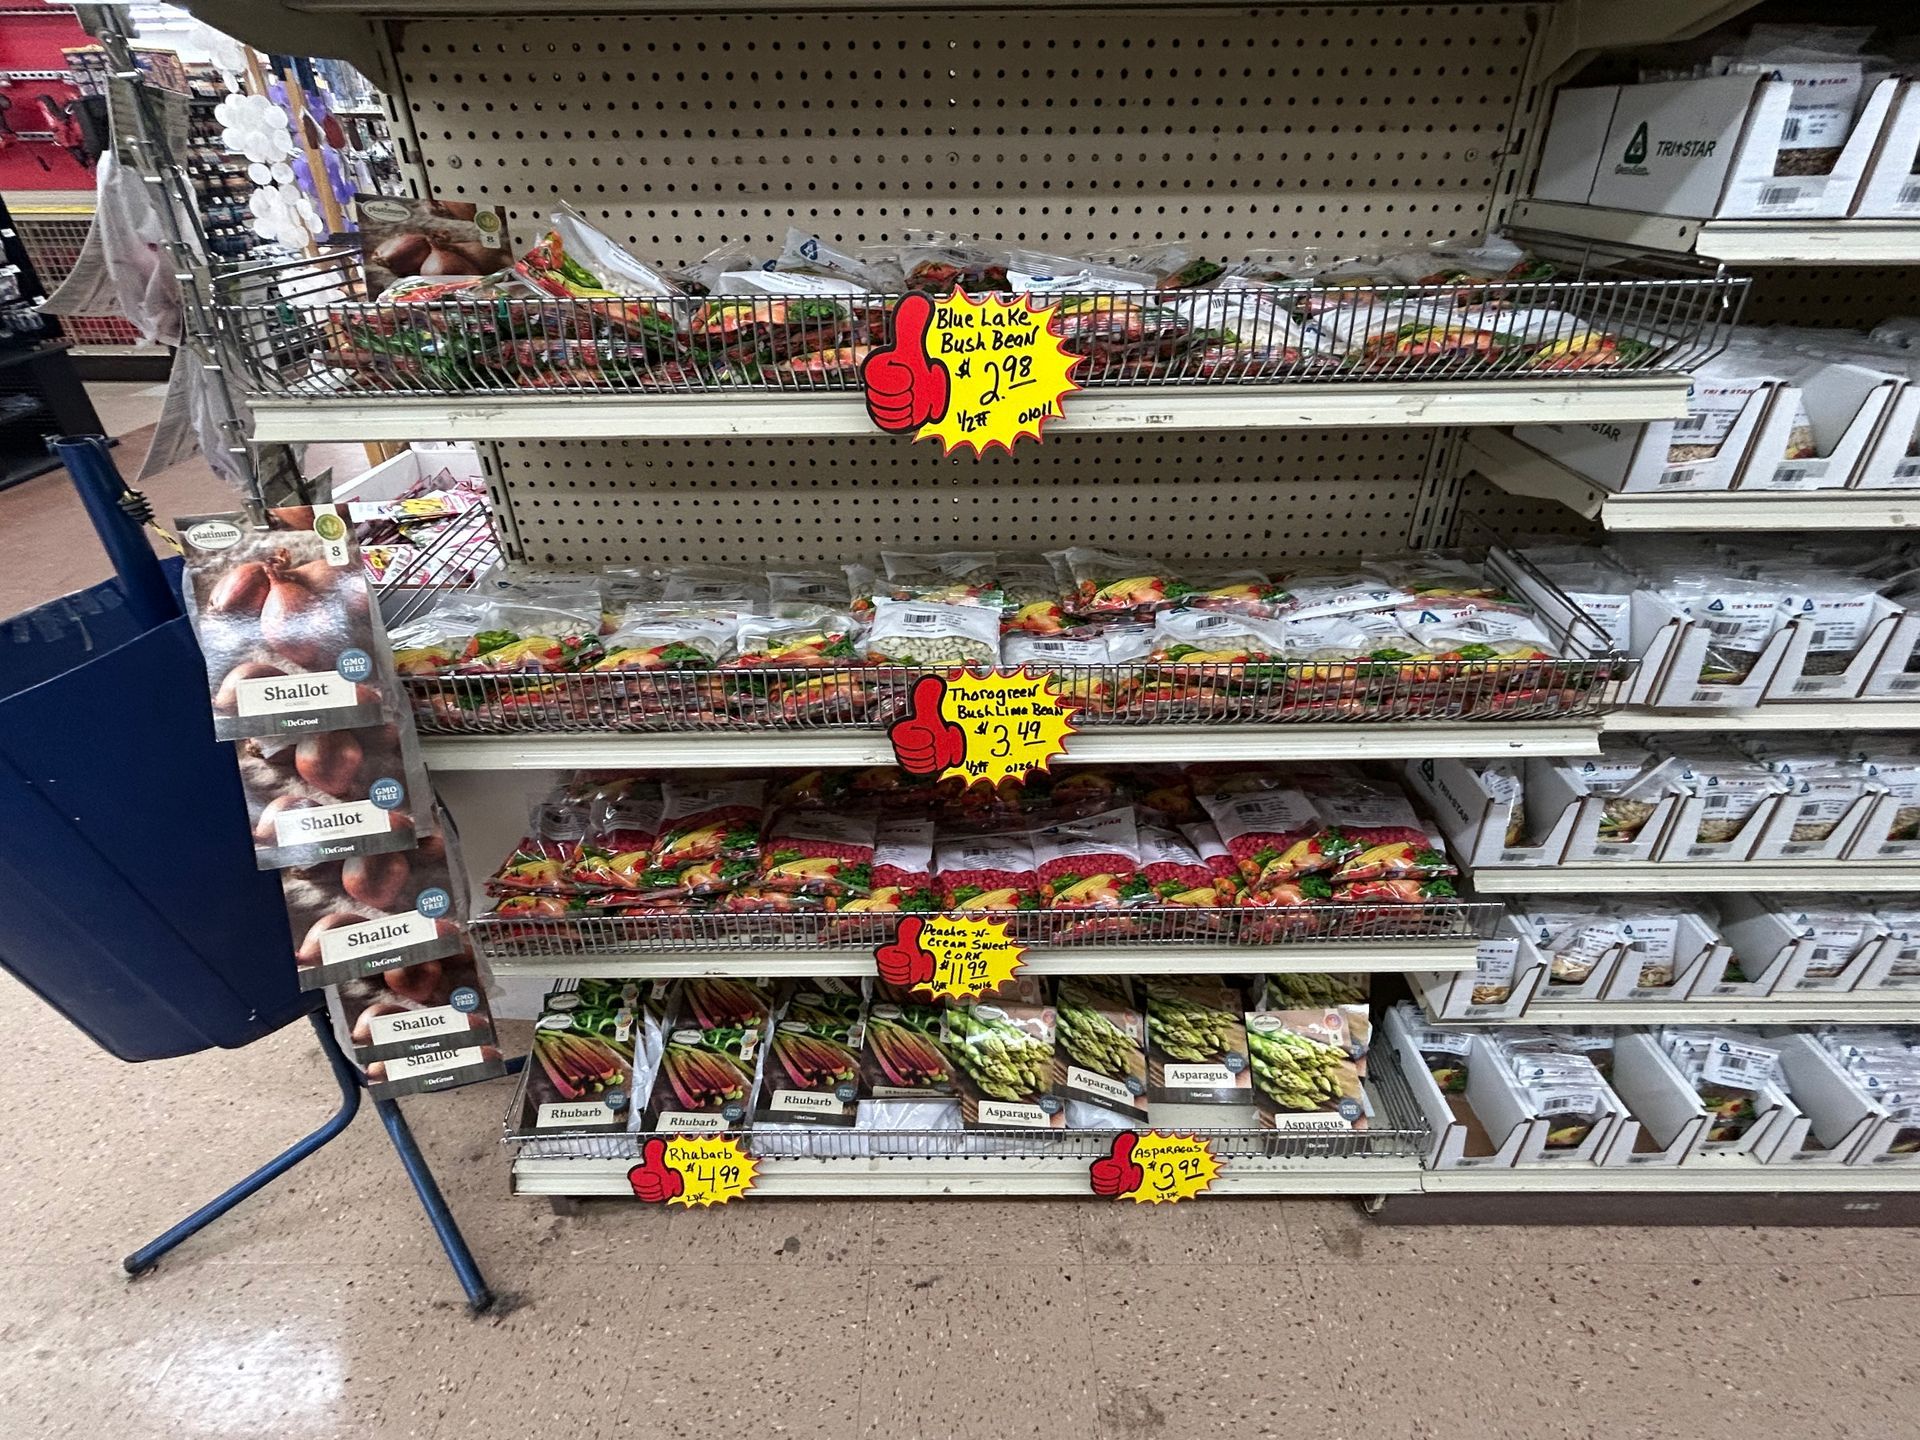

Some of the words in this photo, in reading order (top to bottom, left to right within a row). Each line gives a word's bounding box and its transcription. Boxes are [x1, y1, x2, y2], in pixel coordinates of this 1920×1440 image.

[1656, 140, 1678, 157] TRI
[1682, 140, 1717, 158] STAR
[936, 307, 974, 330] Blue
[940, 332, 986, 354] Bush
[191, 525, 239, 542] platinum
[332, 545, 342, 558] 8
[1451, 609, 1474, 619] TRI
[342, 656, 366, 667] GMO
[344, 664, 366, 674] FREE
[263, 682, 329, 702] Shallot
[958, 704, 994, 719] Bush
[286, 717, 319, 728] DeGroot
[374, 786, 398, 795] GMO
[376, 793, 398, 802] FREE
[300, 811, 364, 831] Shallot
[421, 894, 444, 904] GMO
[423, 902, 446, 912] FREE
[347, 922, 410, 948] Shallot
[971, 938, 1010, 950] Sweet
[454, 993, 474, 1002] GMO
[456, 999, 475, 1007] FREE
[392, 1014, 446, 1032] Shallot
[406, 1048, 461, 1067] Shallot
[1171, 1070, 1229, 1084] Asparagus
[1074, 1073, 1128, 1098] Asparagus
[784, 1096, 832, 1106] Rhubarb
[551, 1108, 602, 1118] Rhubarb
[986, 1107, 1043, 1120] Asparagus
[670, 1117, 718, 1127] Rhubarb
[1284, 1119, 1344, 1130] Asparagus
[669, 1146, 732, 1161] Rhubarb
